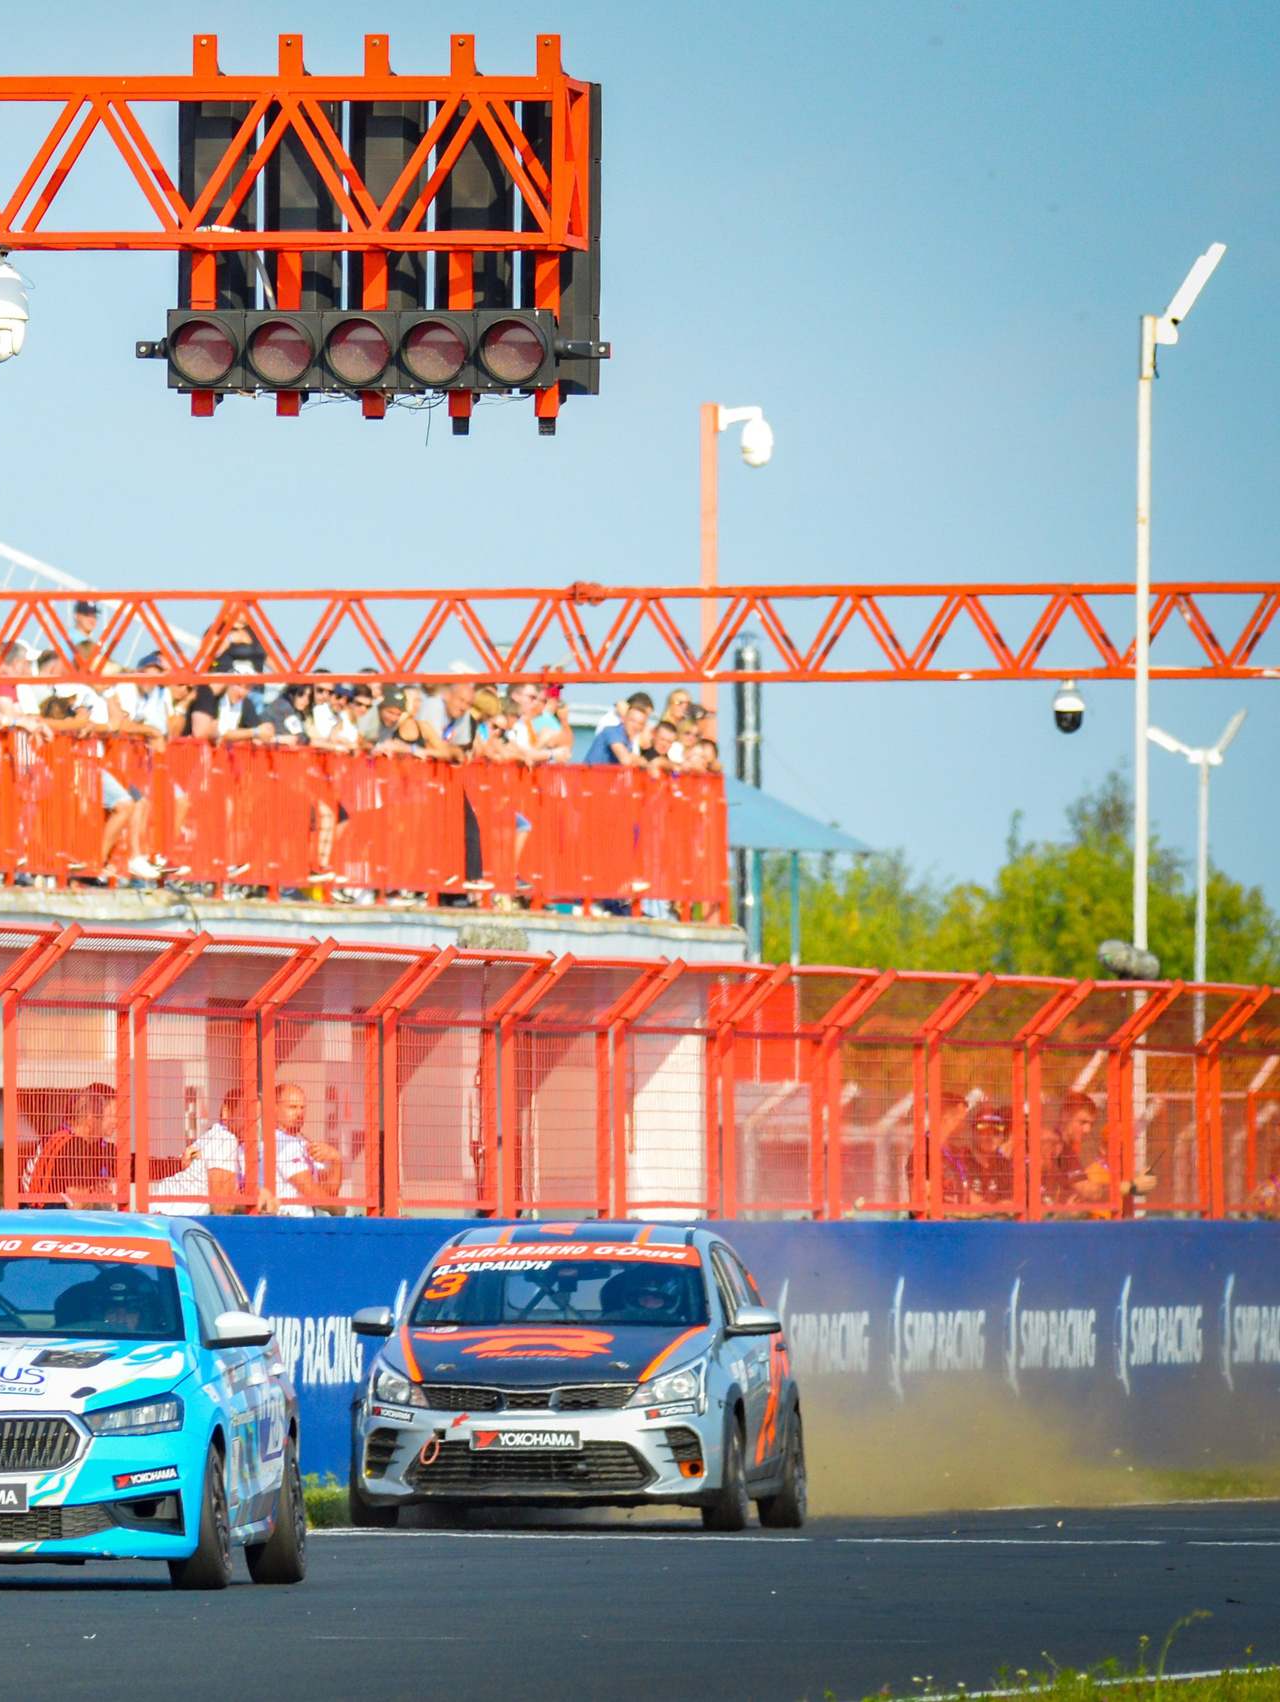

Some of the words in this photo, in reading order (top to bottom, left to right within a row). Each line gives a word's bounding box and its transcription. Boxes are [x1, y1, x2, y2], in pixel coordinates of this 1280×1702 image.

[449, 1245, 588, 1260] ЗАПРАВЛЕНО
[424, 1273, 469, 1299] 3
[303, 1315, 363, 1385] RACING
[789, 1312, 819, 1373] SMP
[820, 1310, 870, 1373] RACING
[904, 1310, 935, 1373] SMP
[936, 1309, 987, 1371] RACING
[1020, 1309, 1048, 1369] SMP
[1048, 1308, 1097, 1368] RACING
[1130, 1306, 1157, 1366] SMP
[1157, 1304, 1203, 1364] RACING
[1233, 1305, 1260, 1363] SMP
[0, 1384, 41, 1393] Seats
[498, 1433, 575, 1446] YOKOHAMA
[130, 1468, 178, 1484] YOKOHAMA
